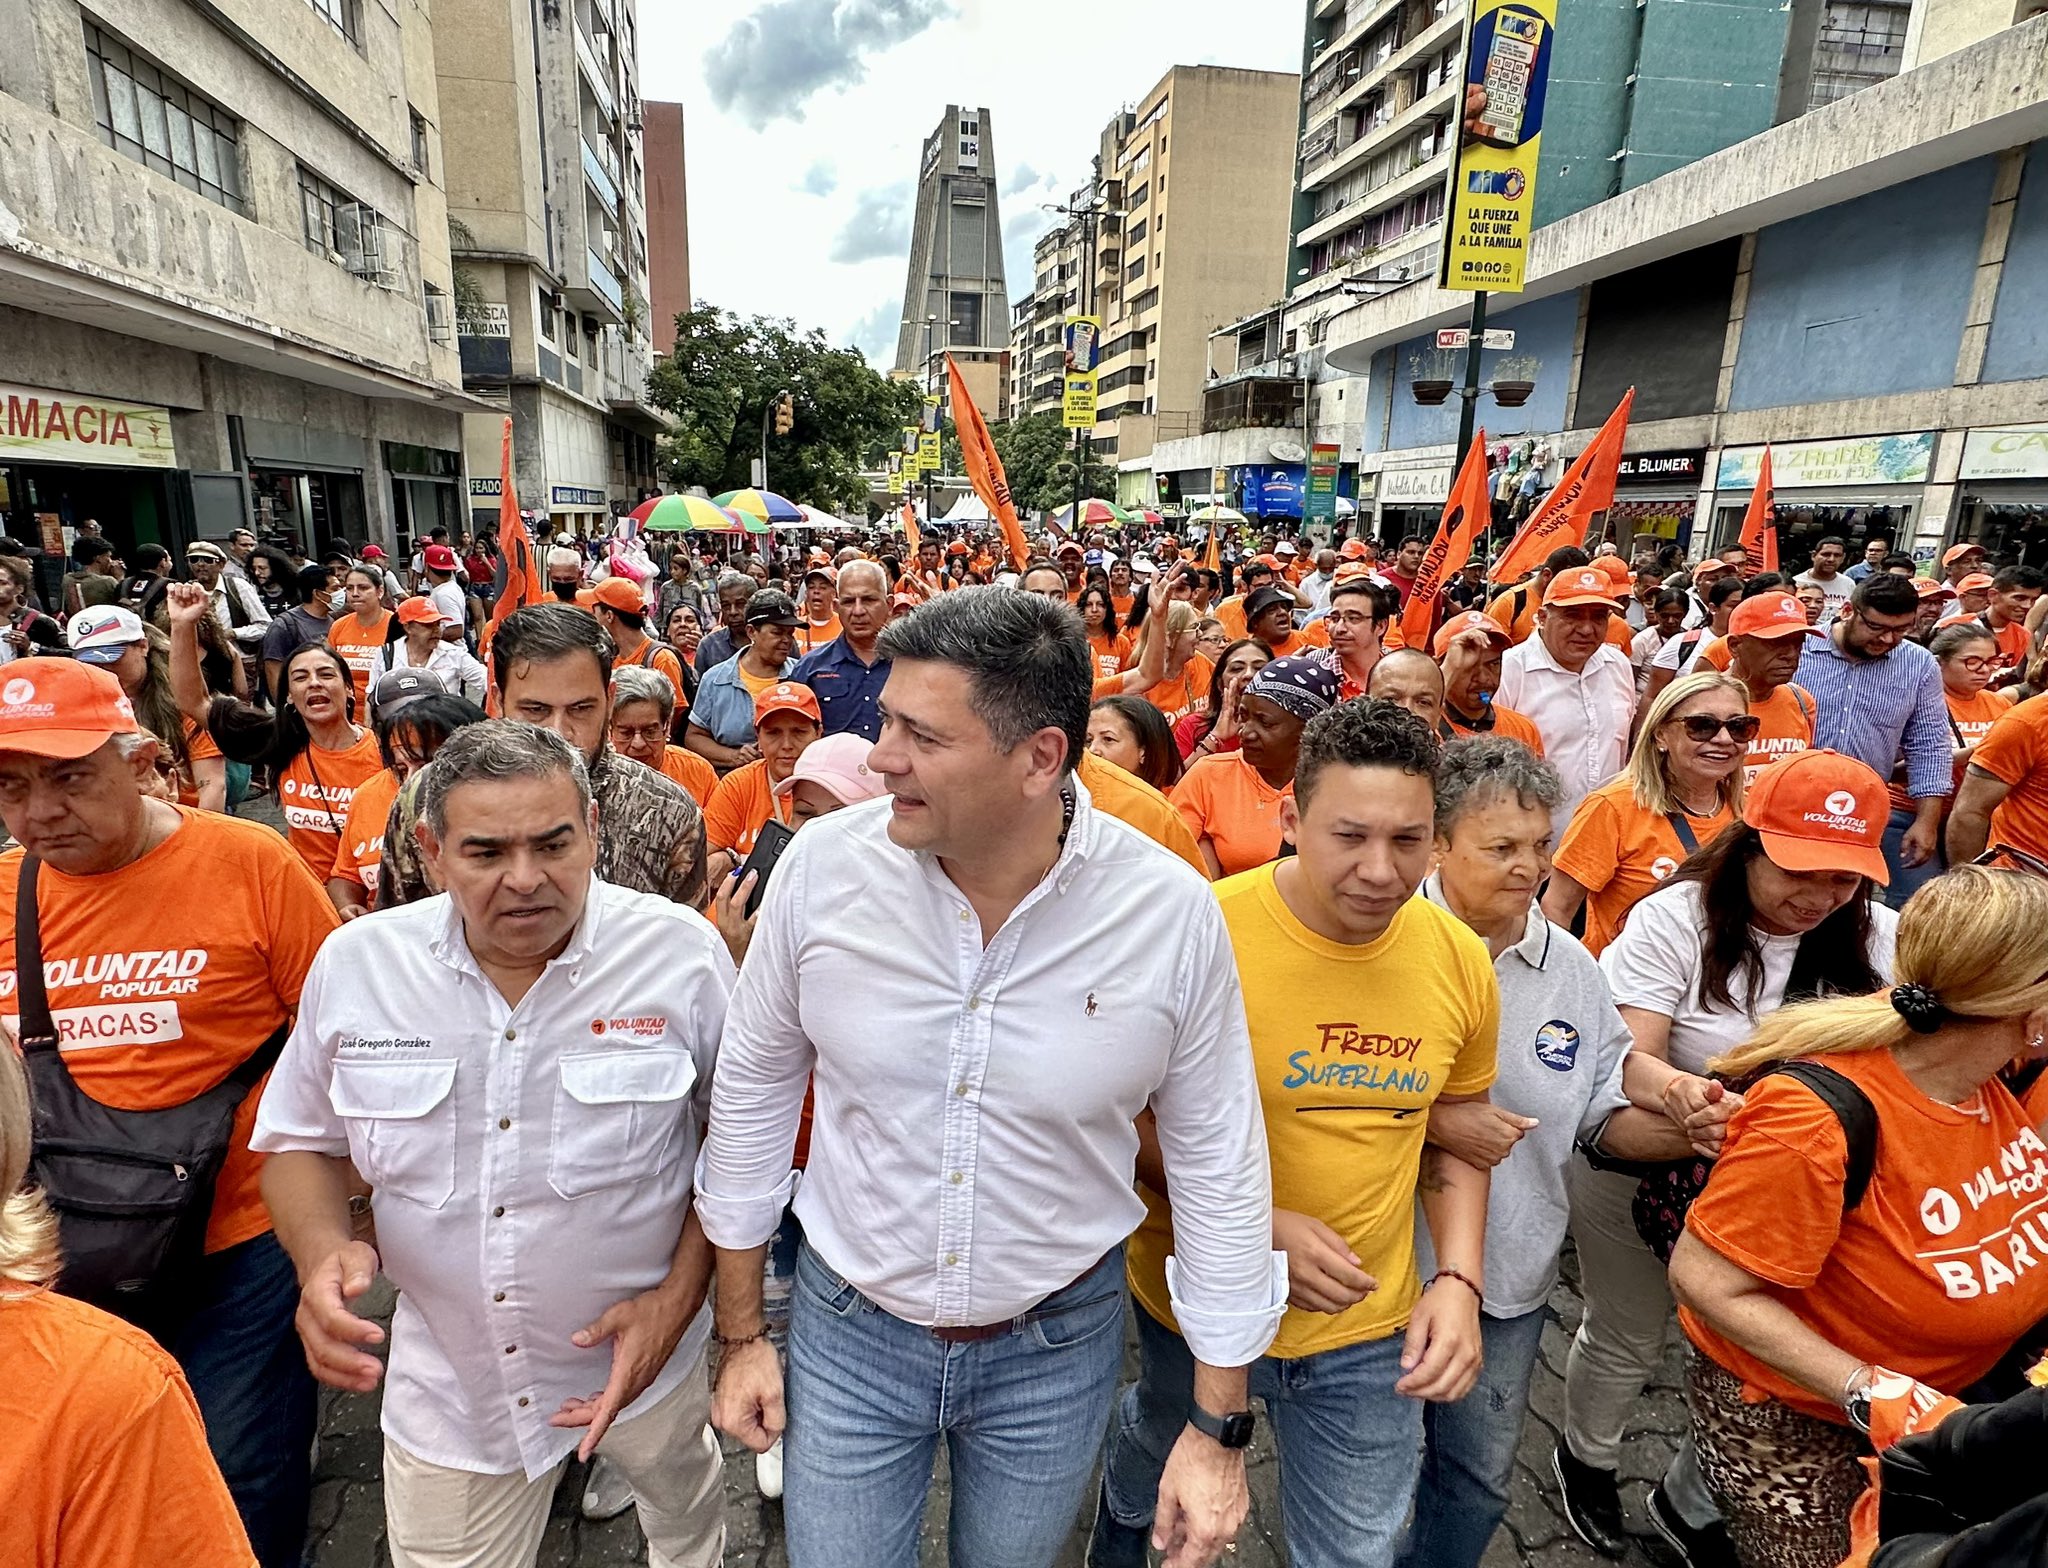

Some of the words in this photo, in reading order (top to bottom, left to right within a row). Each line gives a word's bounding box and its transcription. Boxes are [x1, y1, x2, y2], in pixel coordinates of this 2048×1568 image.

[1468, 208, 1480, 220] LA
[1483, 208, 1520, 222] FUERZA
[1470, 221, 1490, 235] QUE
[1492, 222, 1512, 235] UNE
[1459, 235, 1466, 247] A
[1469, 235, 1481, 247] LA
[1484, 236, 1522, 249] FAMILIA
[1638, 458, 1690, 473] BLUMER
[1803, 811, 1867, 828] VOLUNTAD
[1827, 823, 1867, 835] POPULAR
[100, 978, 200, 999] POPULAR
[58, 1012, 159, 1043] RACAS
[609, 1017, 666, 1030] VOLUNTAD
[634, 1028, 663, 1036] POPULAR
[340, 1036, 357, 1048] José
[358, 1038, 393, 1050] Gregorio
[394, 1036, 431, 1048] González
[1315, 1022, 1422, 1062] FREDDY
[1282, 1050, 1430, 1093] SUPERLANO
